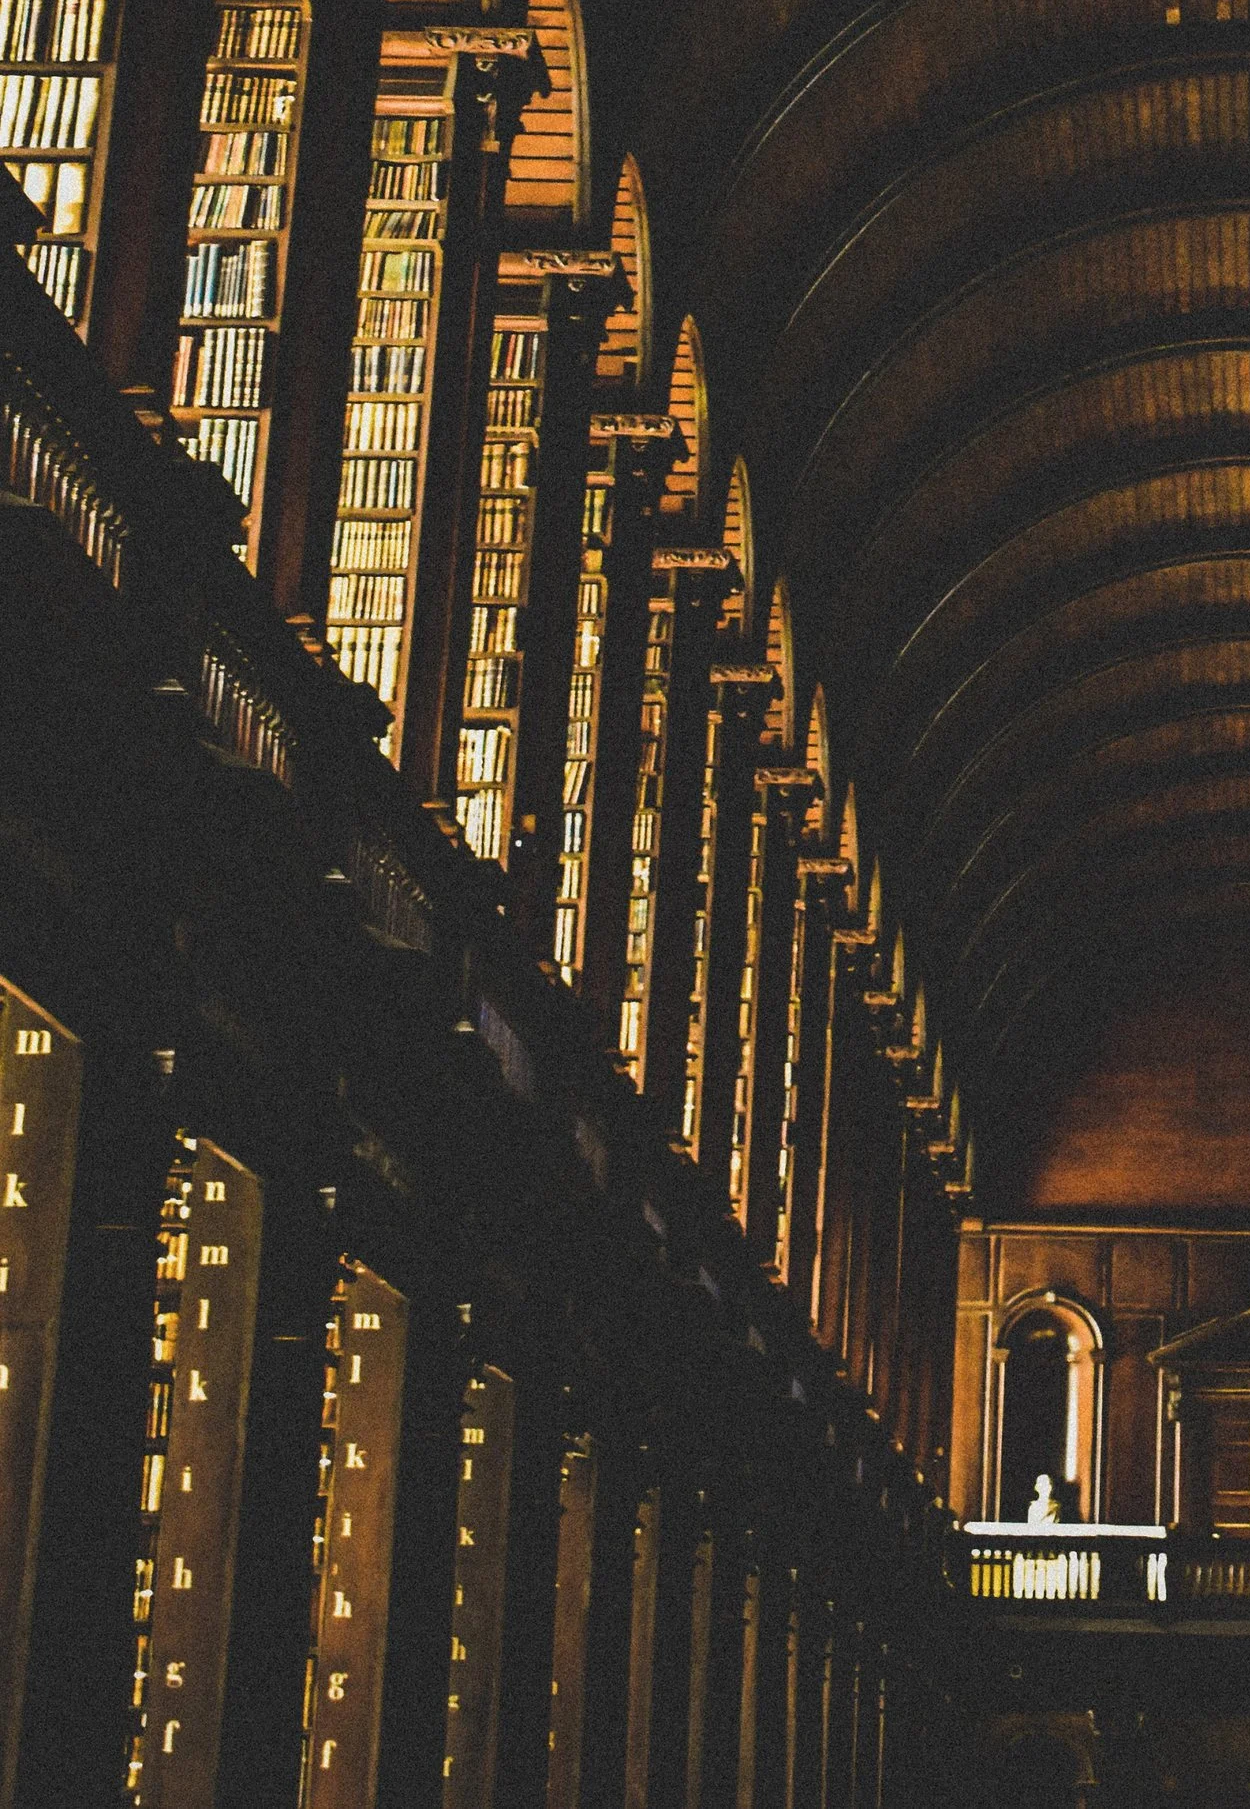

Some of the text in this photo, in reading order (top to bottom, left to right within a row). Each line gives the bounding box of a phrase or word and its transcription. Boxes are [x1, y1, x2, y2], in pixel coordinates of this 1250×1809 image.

[15, 1029, 52, 1055] m
[11, 1103, 26, 1136] l
[3, 1173, 28, 1207] k
[205, 1181, 226, 1202] n
[199, 1245, 229, 1266] m
[198, 1298, 210, 1330] l
[353, 1312, 381, 1330] m
[349, 1354, 362, 1384] l
[188, 1369, 207, 1402] k
[463, 1428, 485, 1444] m
[345, 1443, 366, 1469] k
[181, 1466, 192, 1492] i
[463, 1459, 472, 1481] l
[341, 1512, 352, 1537] i
[460, 1527, 474, 1546] k
[172, 1557, 192, 1590] h
[332, 1591, 352, 1618] h
[451, 1637, 466, 1660] h
[166, 1662, 186, 1687] g
[327, 1672, 349, 1701] g
[162, 1720, 181, 1754] f
[320, 1739, 337, 1769] f
